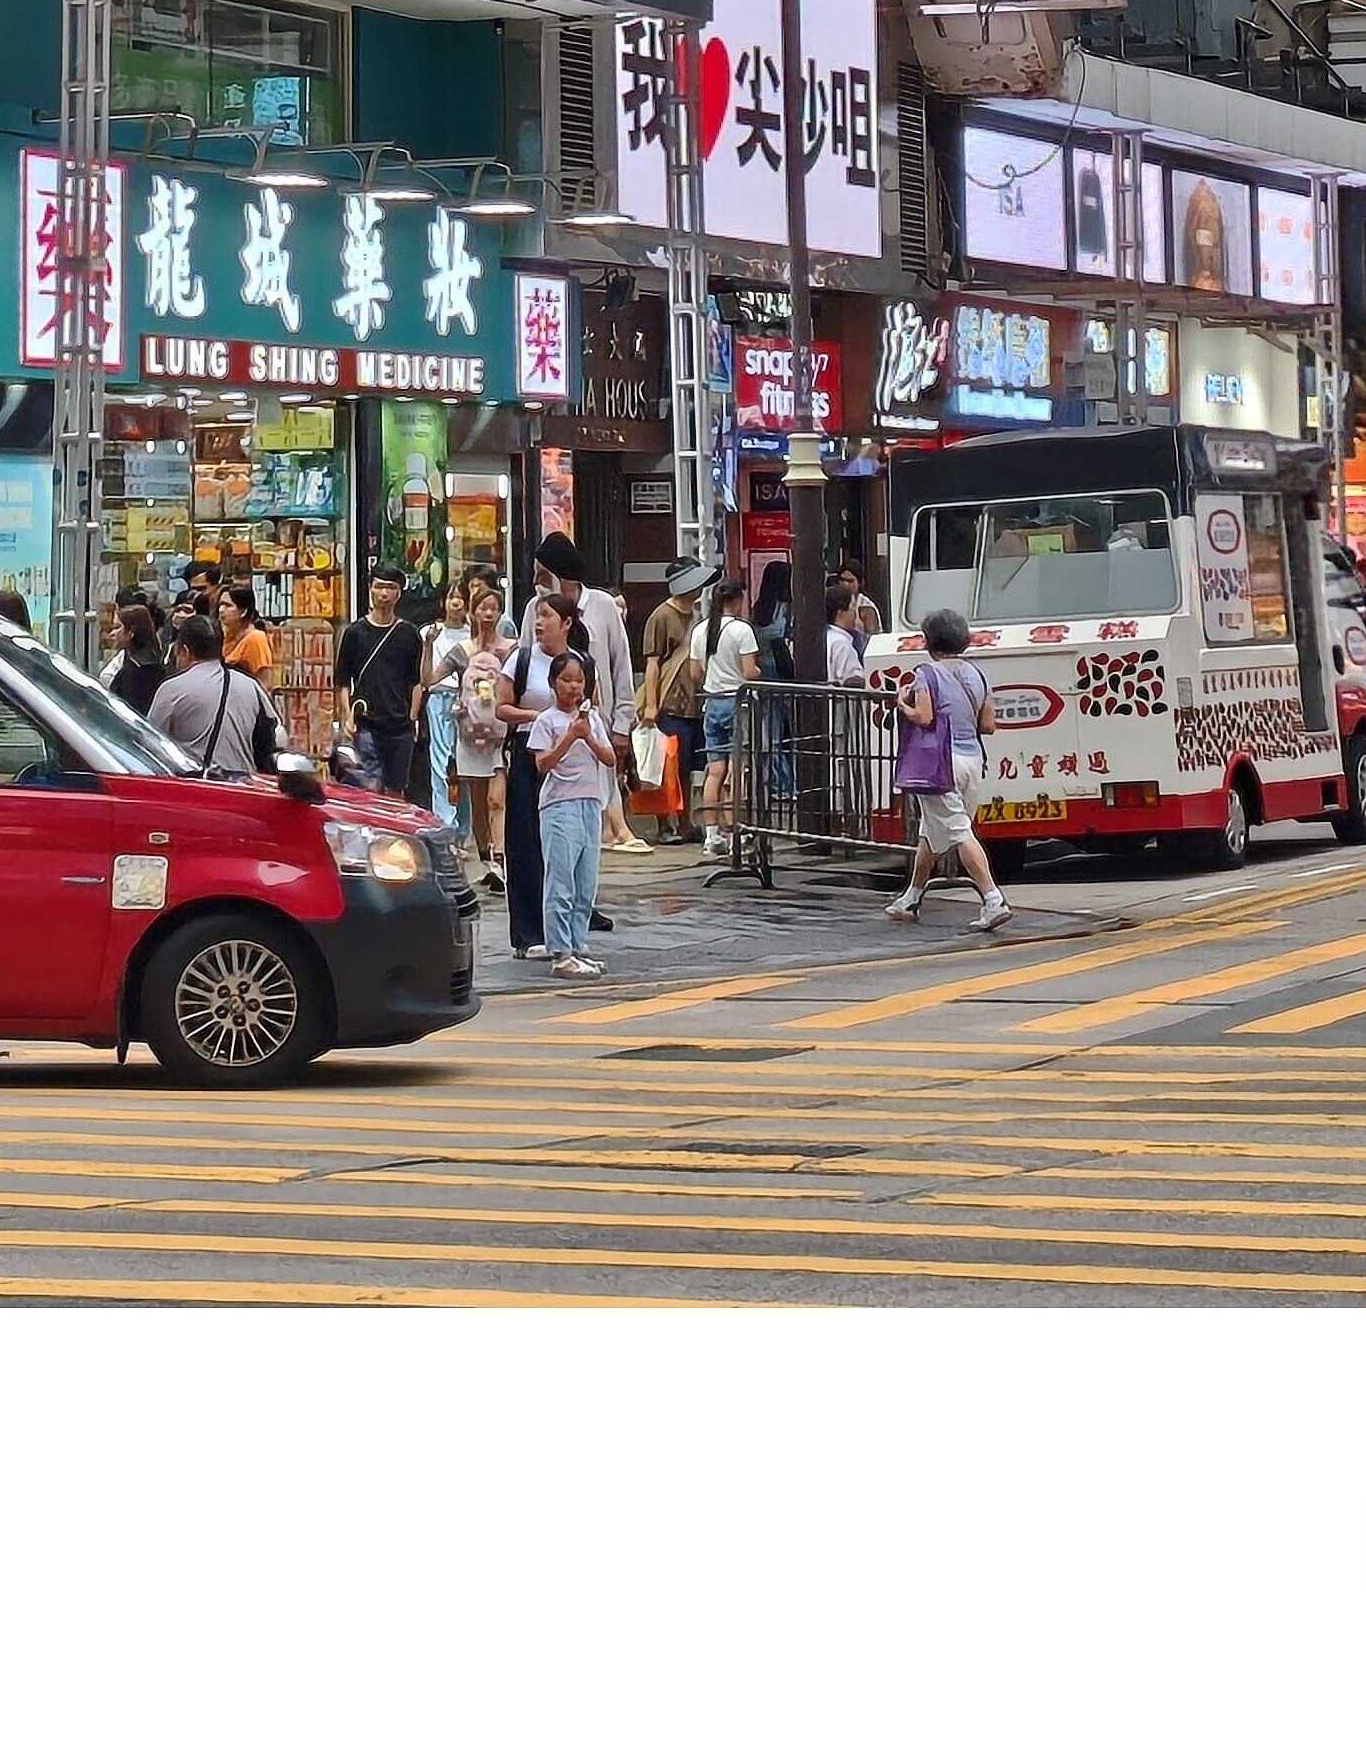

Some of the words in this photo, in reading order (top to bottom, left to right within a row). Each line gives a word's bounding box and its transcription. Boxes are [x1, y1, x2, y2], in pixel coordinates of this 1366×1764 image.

[136, 173, 486, 342] 龍城藥妝
[144, 336, 230, 379] LUNG
[249, 343, 339, 387] SHING
[355, 349, 487, 395] MEDICINE
